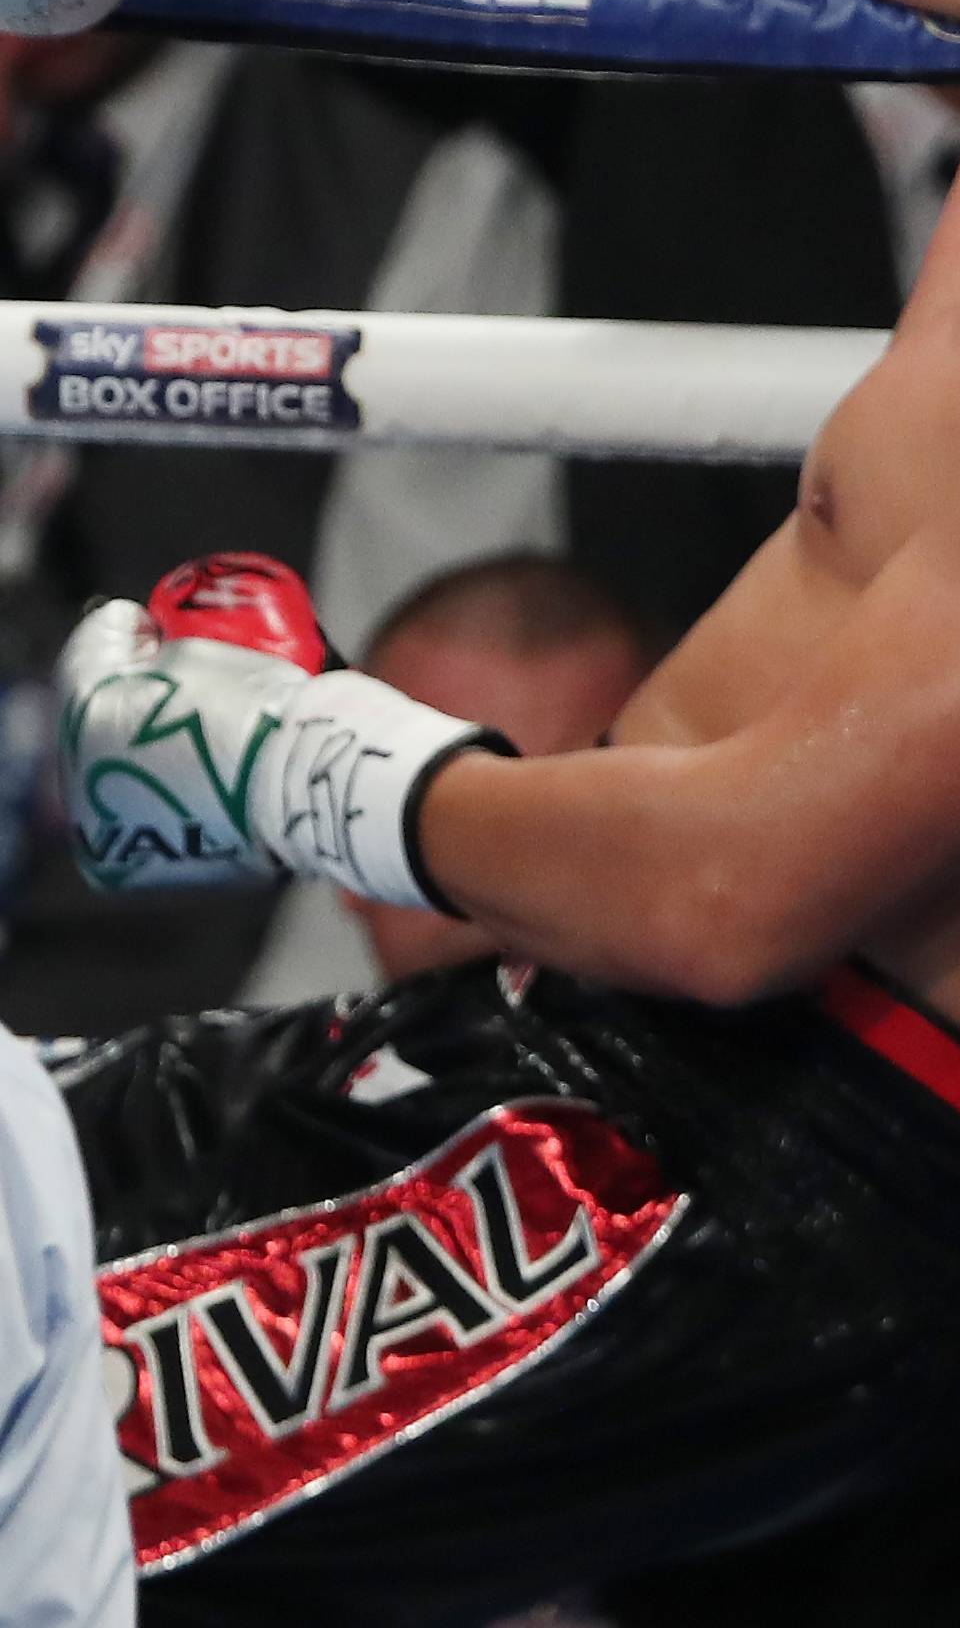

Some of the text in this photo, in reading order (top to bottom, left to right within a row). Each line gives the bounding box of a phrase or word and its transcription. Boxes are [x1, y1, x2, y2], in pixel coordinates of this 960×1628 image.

[69, 326, 322, 370] sky SPORTS
[57, 374, 334, 423] BOX OFFICE
